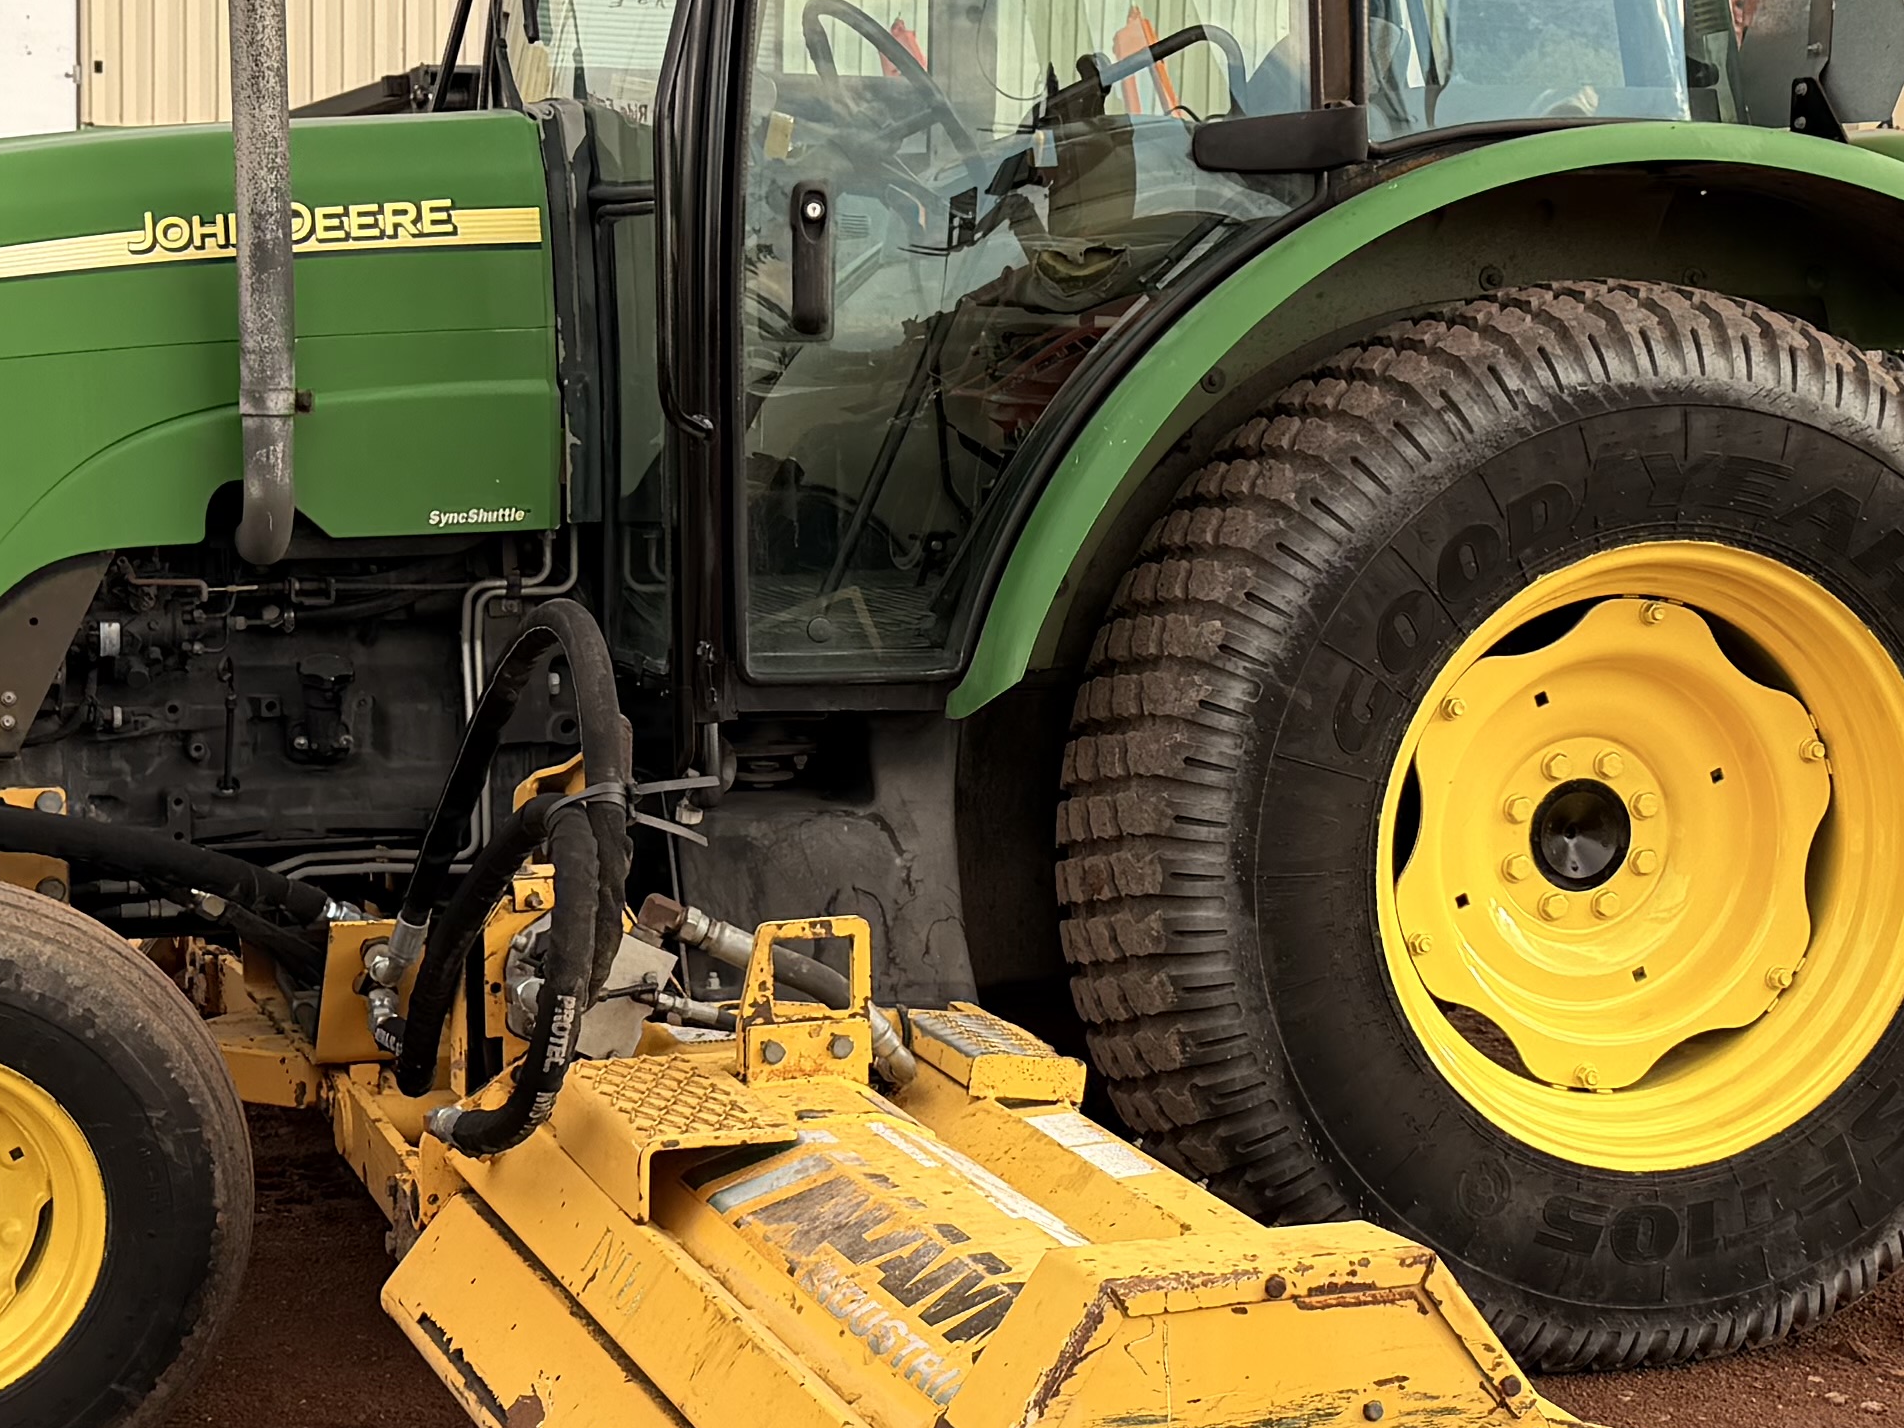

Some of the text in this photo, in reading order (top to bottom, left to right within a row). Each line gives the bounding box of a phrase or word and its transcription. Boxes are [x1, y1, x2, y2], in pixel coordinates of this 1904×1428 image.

[127, 211, 236, 253] JOH
[428, 507, 525, 528] SyncShuttle
[733, 1172, 1026, 1368] ALAM
